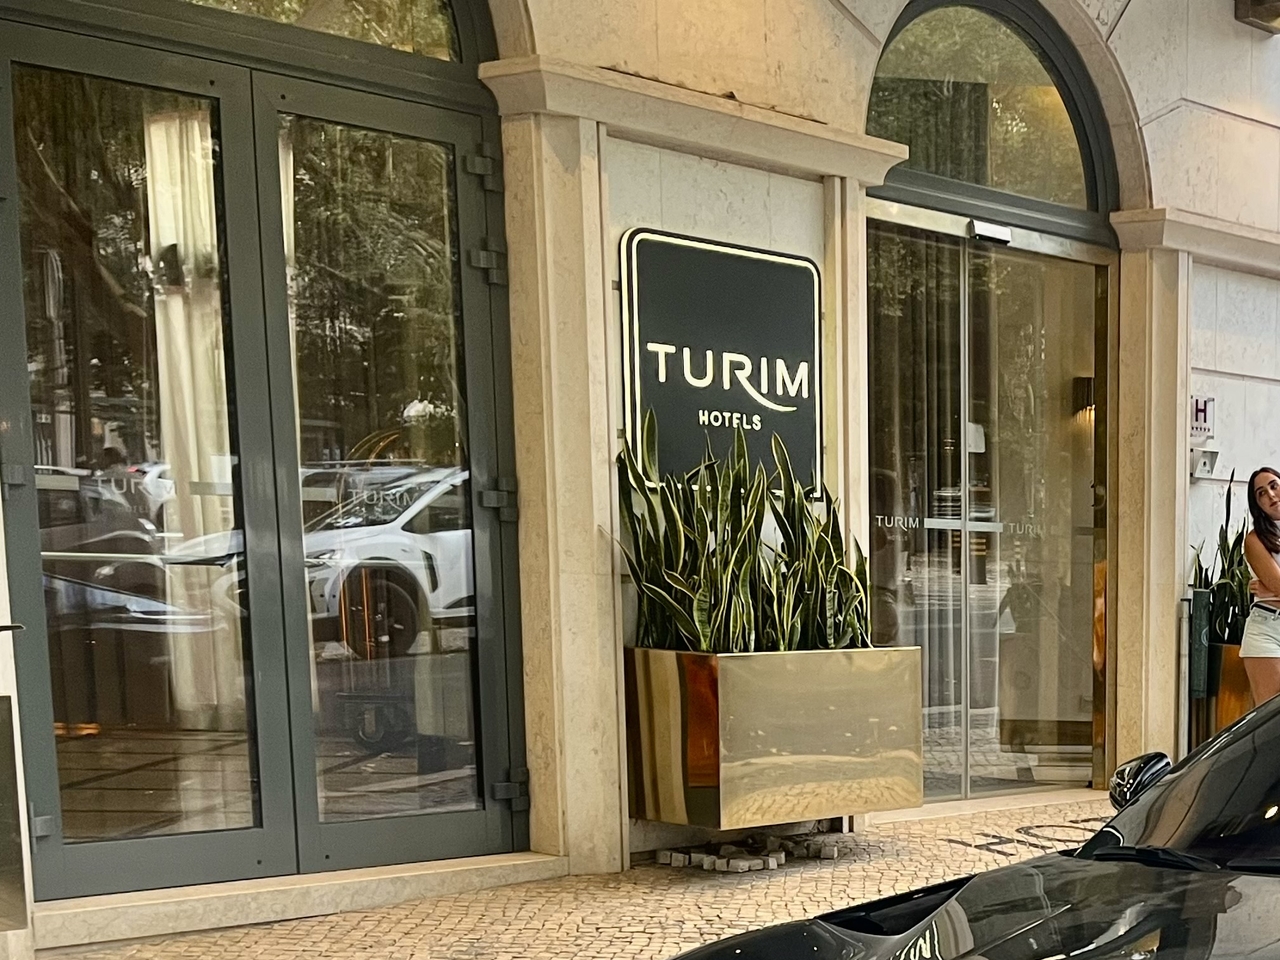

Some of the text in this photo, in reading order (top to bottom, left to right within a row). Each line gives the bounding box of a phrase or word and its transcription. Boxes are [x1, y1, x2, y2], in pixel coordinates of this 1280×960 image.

[647, 342, 809, 412] TURIM
[699, 409, 762, 431] HOTELS
[1195, 398, 1207, 423] H
[875, 515, 919, 531] TURIM
